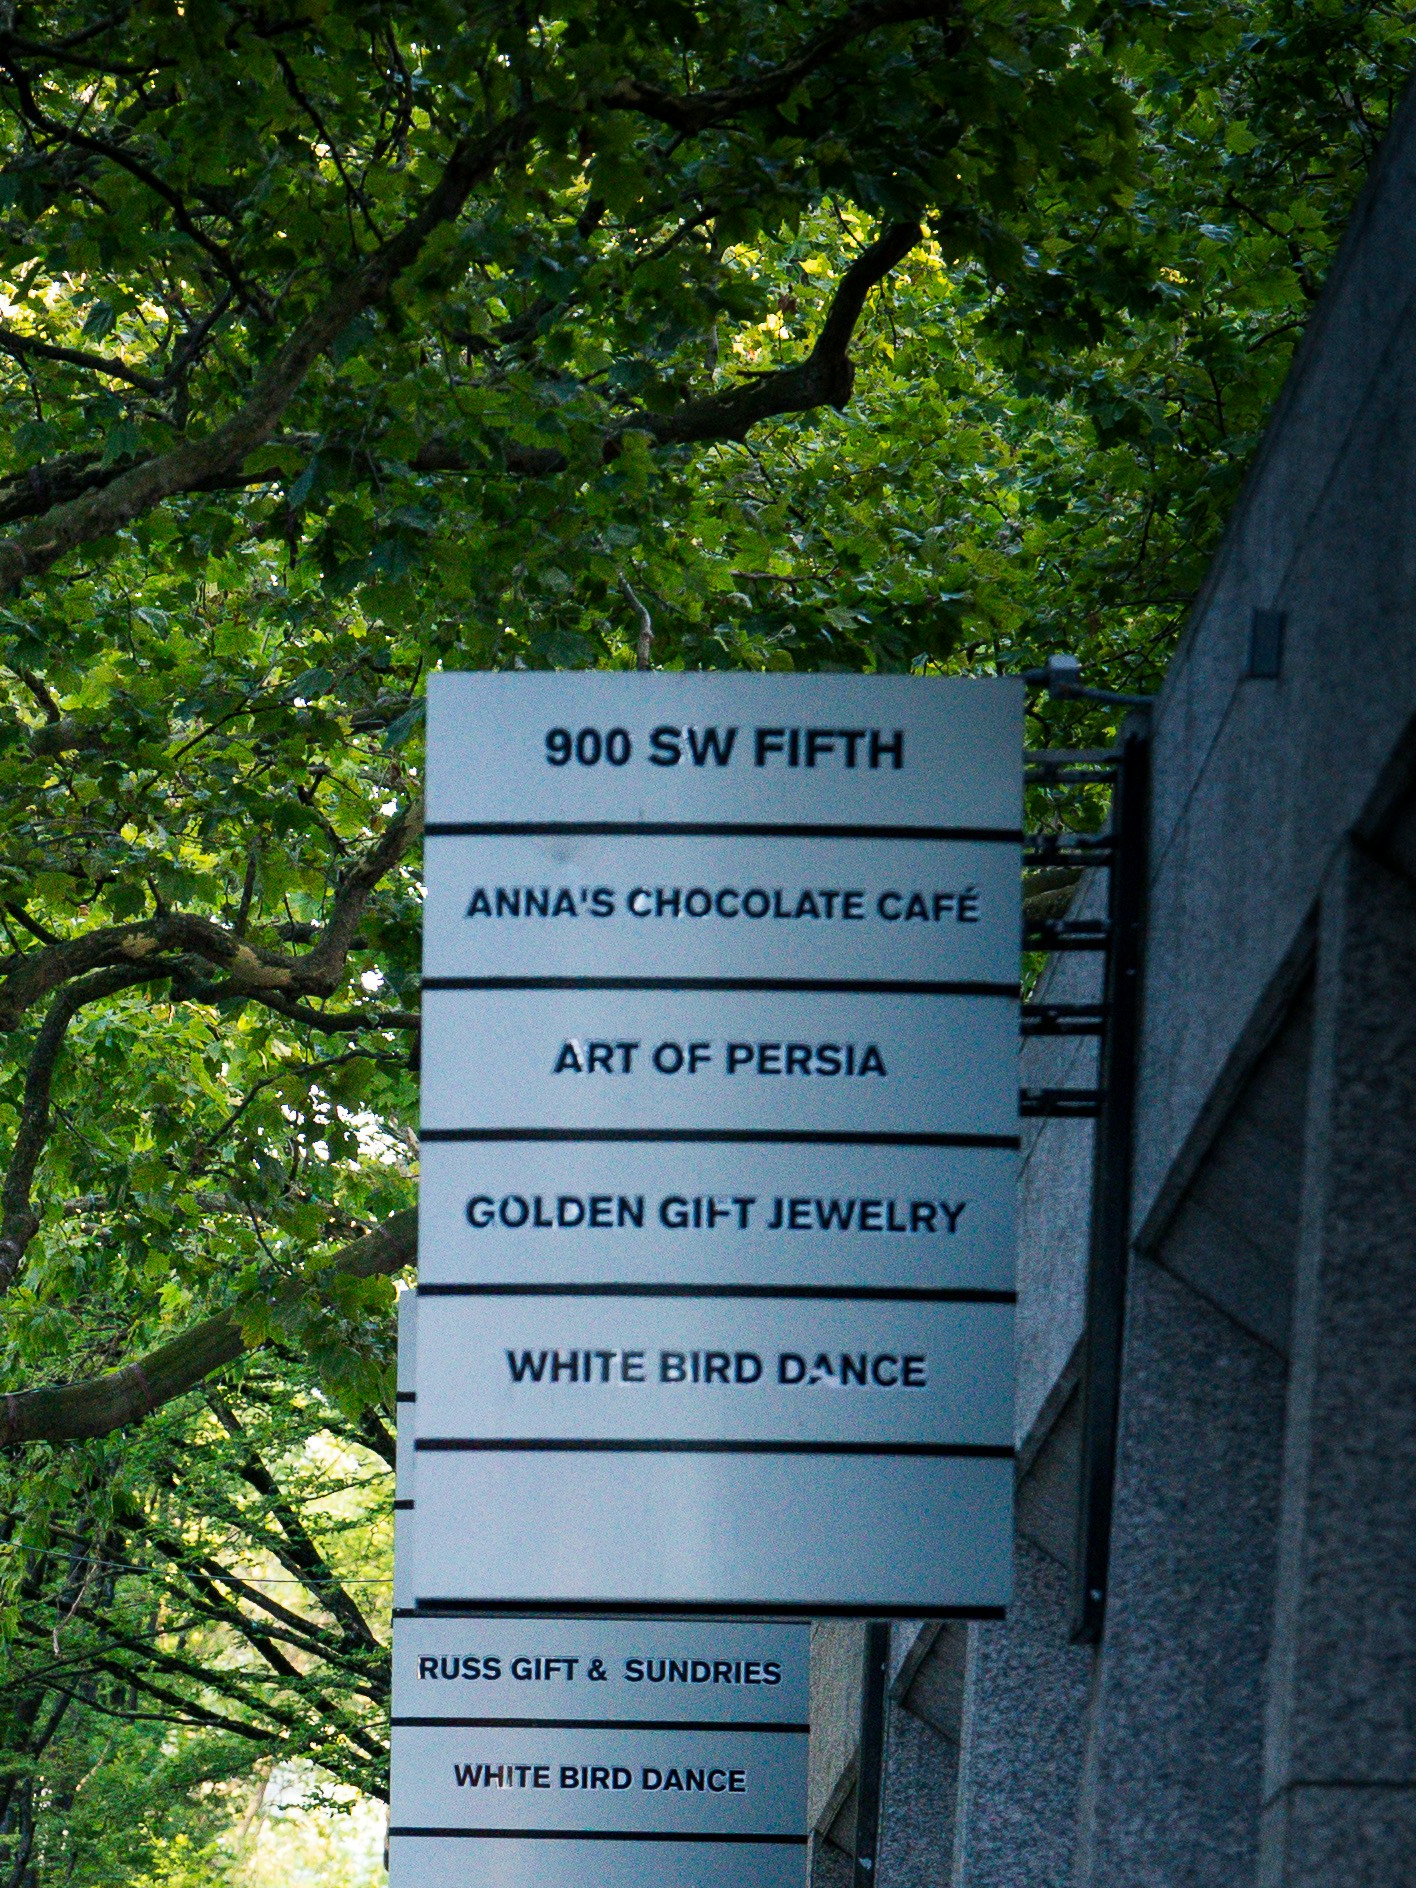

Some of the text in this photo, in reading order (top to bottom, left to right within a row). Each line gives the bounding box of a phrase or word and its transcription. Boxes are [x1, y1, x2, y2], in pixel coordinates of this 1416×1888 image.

[545, 725, 904, 770] 900 SW FIFTH
[466, 886, 979, 924] ANNA'S CHOCOLATE CAFÉ
[553, 1041, 888, 1077] ART OF PERSIA
[465, 1195, 967, 1235] GOLDEN GIFT JEWELRY
[506, 1350, 927, 1388] WHITE BIRD DANCE
[419, 1656, 782, 1686] RUSS GIFT & SUNDRIES
[453, 1764, 746, 1793] WHITE BIRD DANCE
